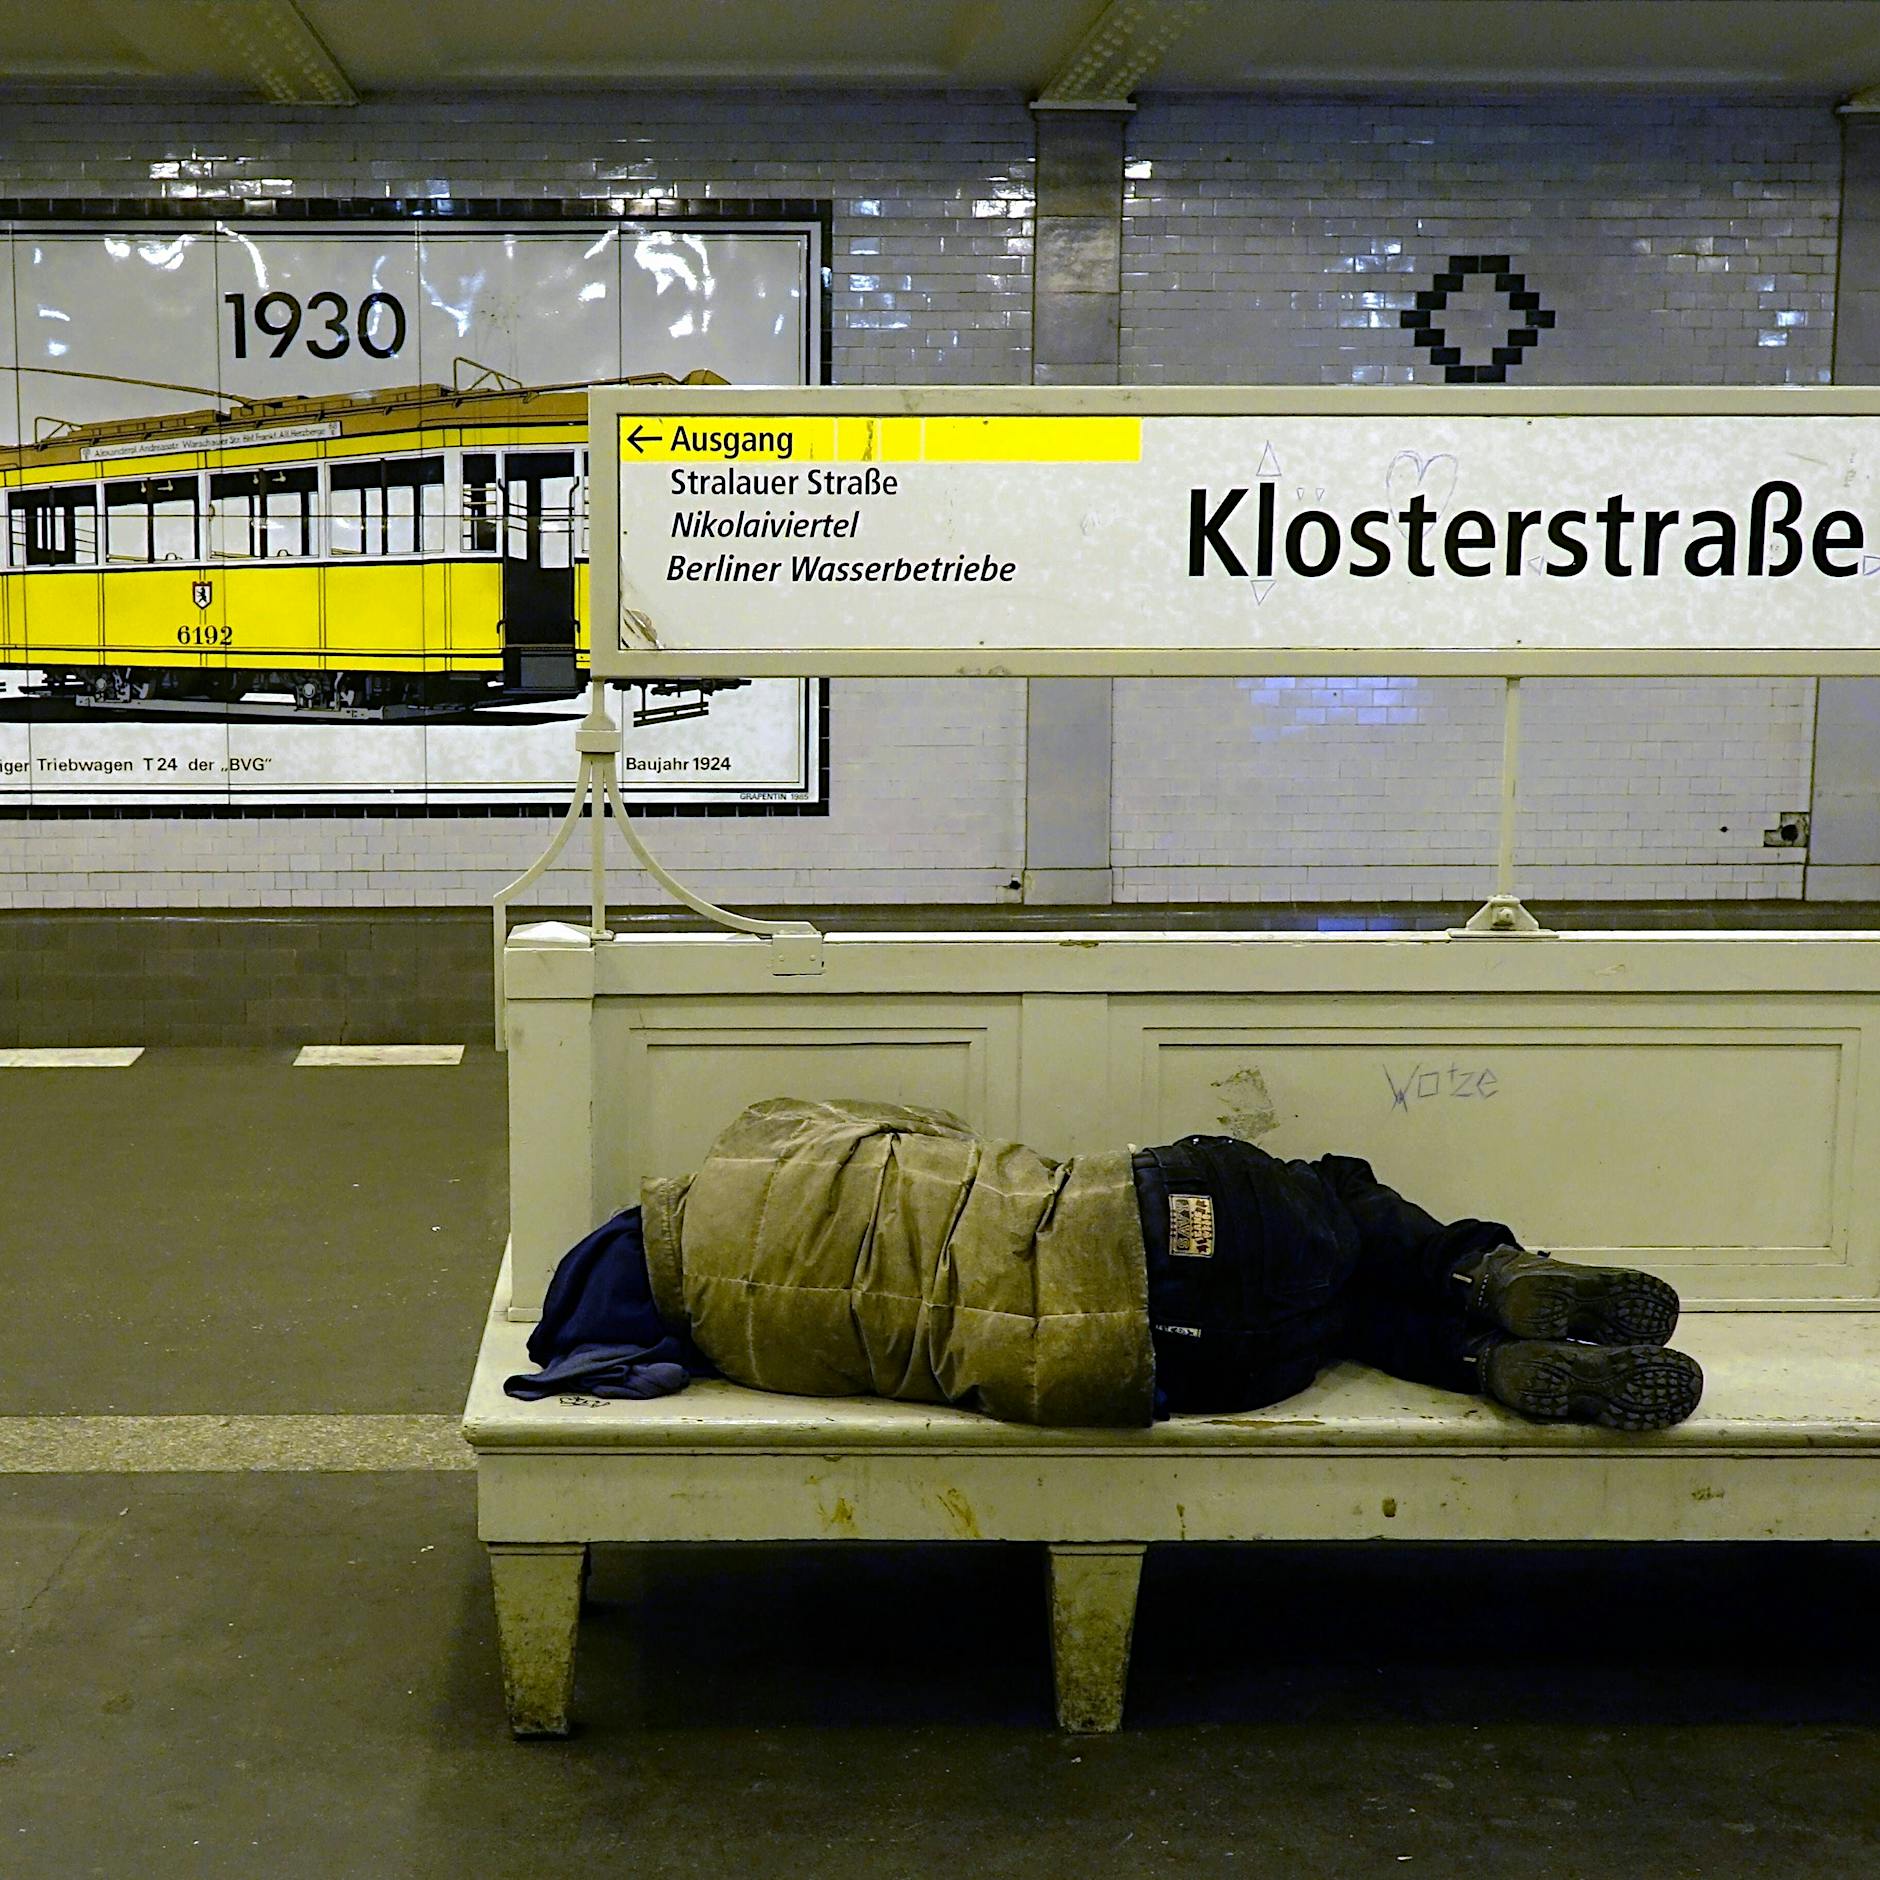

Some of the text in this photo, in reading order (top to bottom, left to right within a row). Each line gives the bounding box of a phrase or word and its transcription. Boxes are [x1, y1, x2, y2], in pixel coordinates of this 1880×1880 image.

[225, 291, 407, 360] 1930
[671, 425, 793, 459] Ausgang
[671, 467, 898, 495] Stralauer Straße
[671, 510, 859, 539] Nikolaiviertel
[1189, 480, 1864, 577] Klosterstraße
[667, 554, 1016, 582] Berliner Wasserbetriebe
[177, 625, 233, 646] 6192
[37, 758, 133, 775] Triebwagen
[188, 758, 215, 771] der
[626, 757, 731, 774] Baujahr 1924
[739, 792, 787, 801] GRAPENTIN
